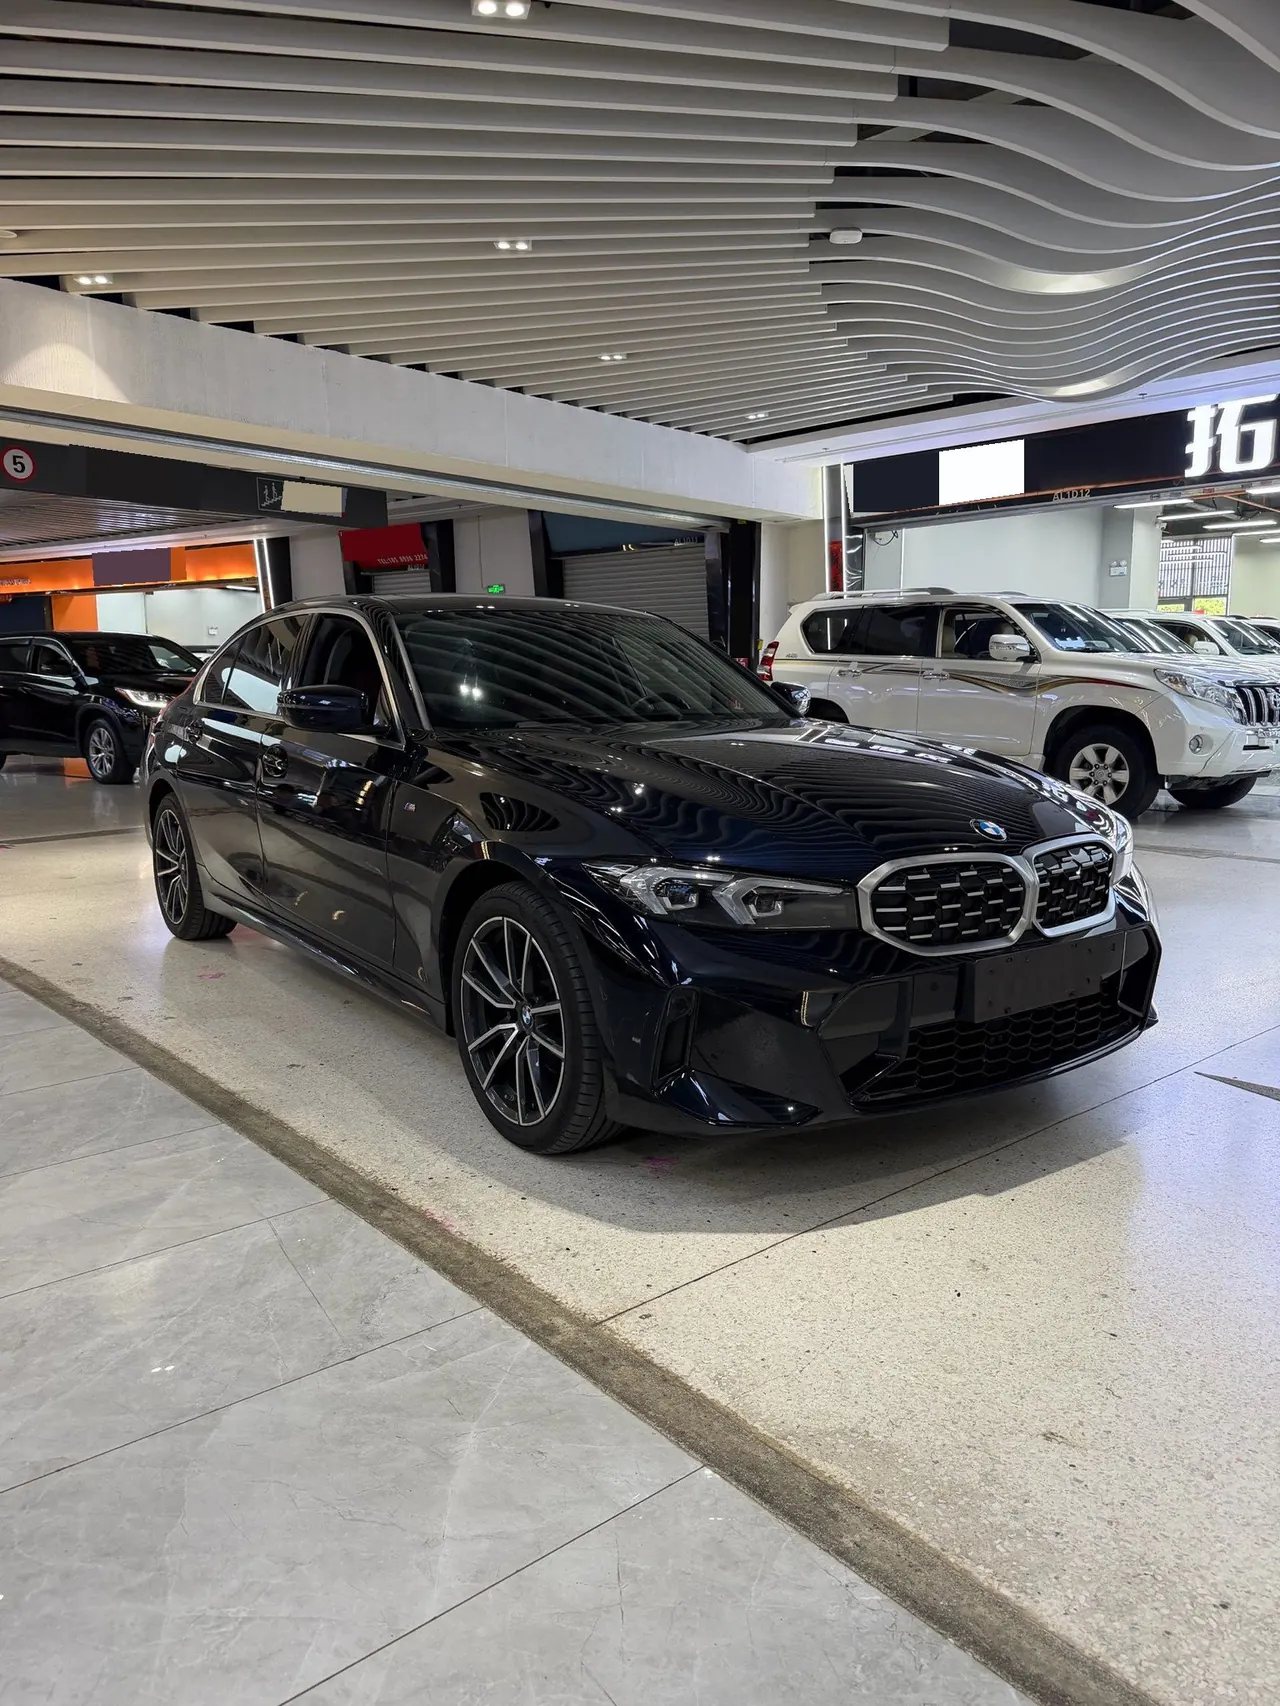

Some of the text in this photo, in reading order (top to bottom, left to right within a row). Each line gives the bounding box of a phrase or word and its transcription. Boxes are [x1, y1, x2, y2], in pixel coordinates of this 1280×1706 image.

[1184, 393, 1278, 478] 拓
[12, 455, 26, 473] 5
[1052, 488, 1091, 502] AL1D12
